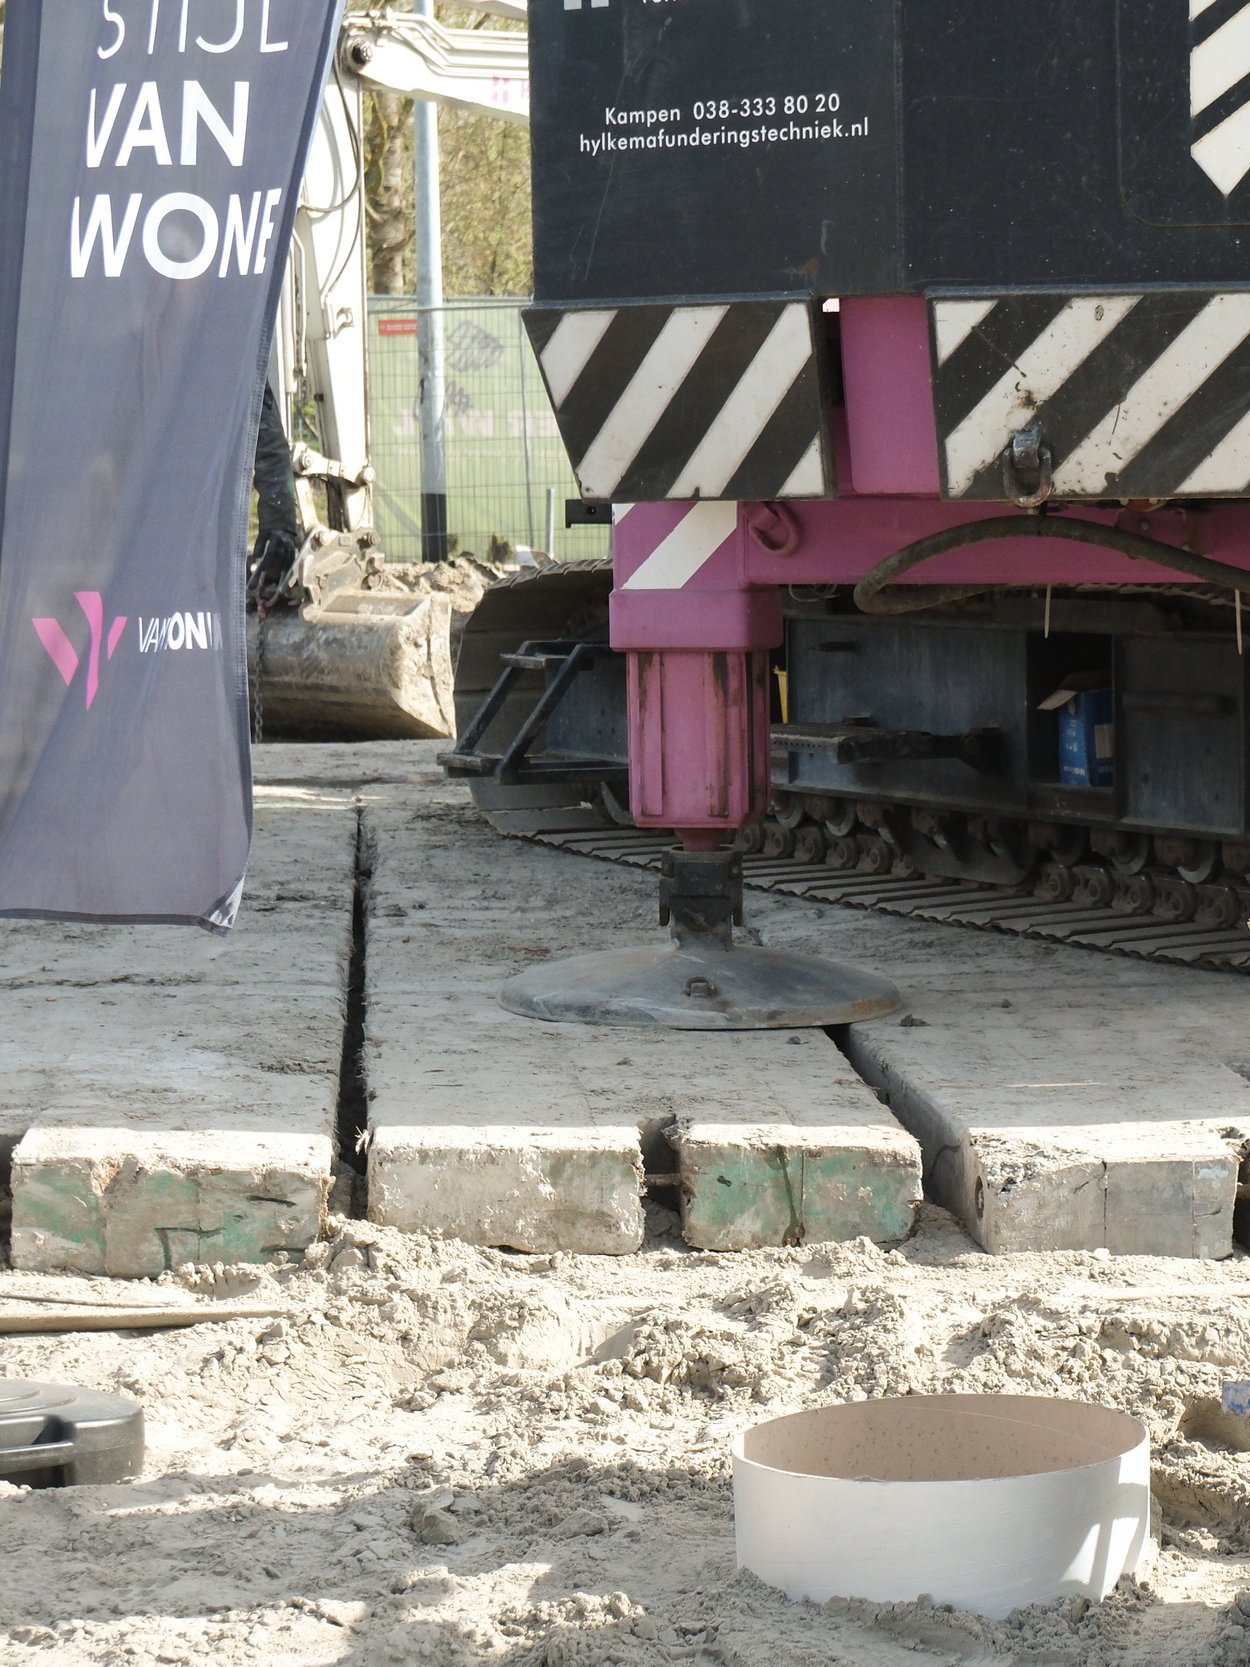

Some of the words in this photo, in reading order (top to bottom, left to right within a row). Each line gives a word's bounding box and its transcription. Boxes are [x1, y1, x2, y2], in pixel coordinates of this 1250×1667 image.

[86, 80, 249, 168] VAN
[579, 117, 869, 156] hylkemafunderingstechniek.nl
[605, 106, 681, 127] Kampen
[693, 97, 776, 120] 038-333
[783, 95, 808, 114] 80
[815, 93, 840, 113] 20
[70, 188, 282, 280] WONE
